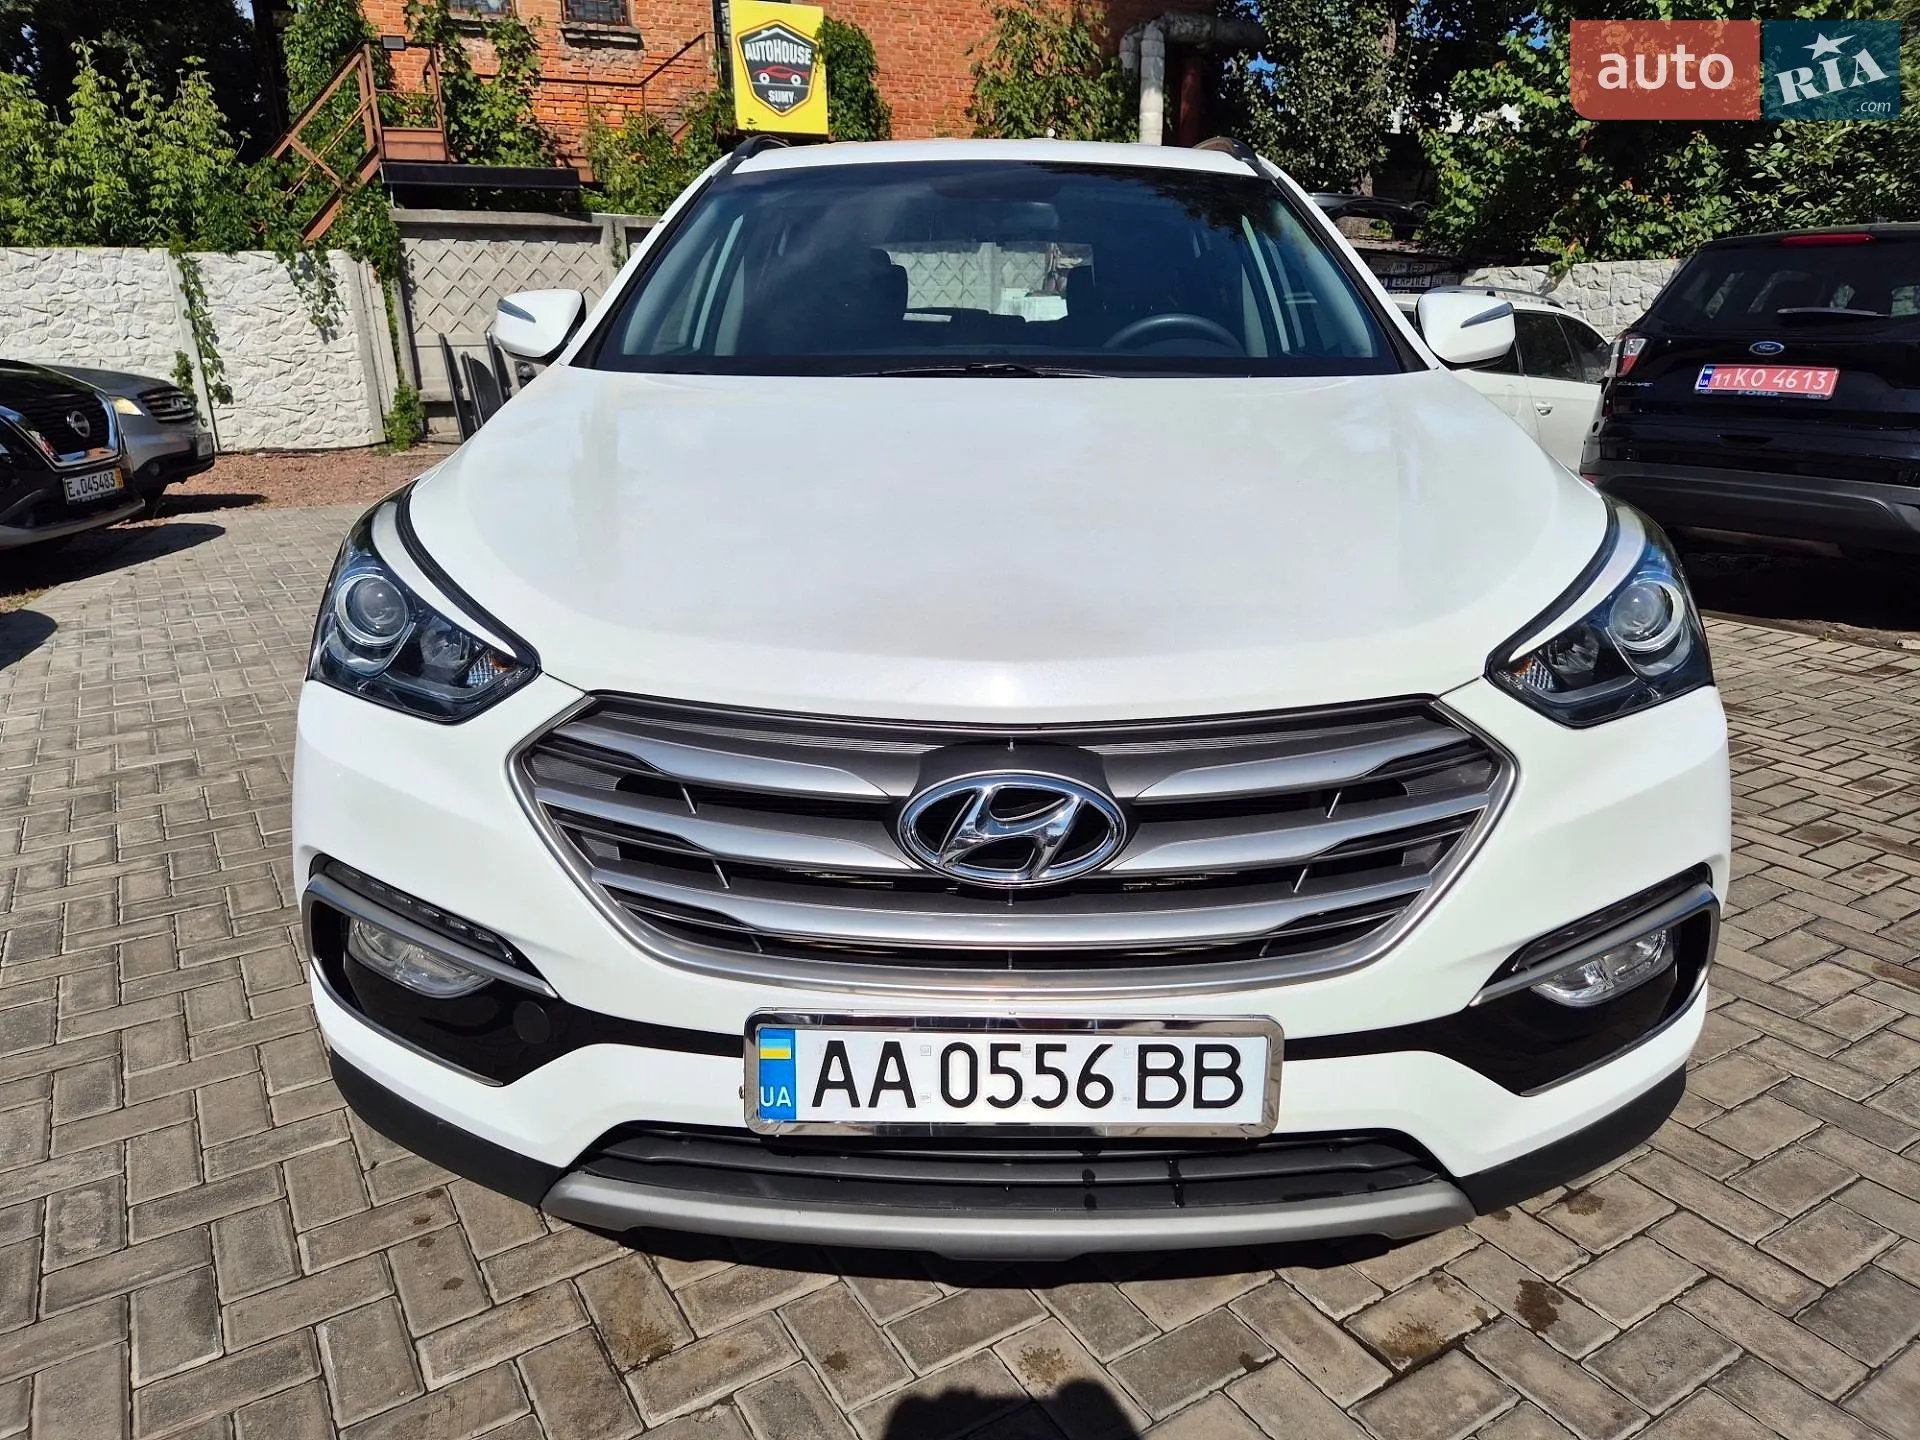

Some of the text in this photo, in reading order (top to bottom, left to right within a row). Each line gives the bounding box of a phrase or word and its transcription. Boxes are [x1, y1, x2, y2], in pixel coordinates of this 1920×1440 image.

[744, 39, 812, 65] AUTOHOUSE
[768, 90, 795, 104] SUMY
[1772, 369, 1828, 390] 4613
[811, 1040, 1244, 1109] AA 0556 BB
[760, 1085, 792, 1107] UA
